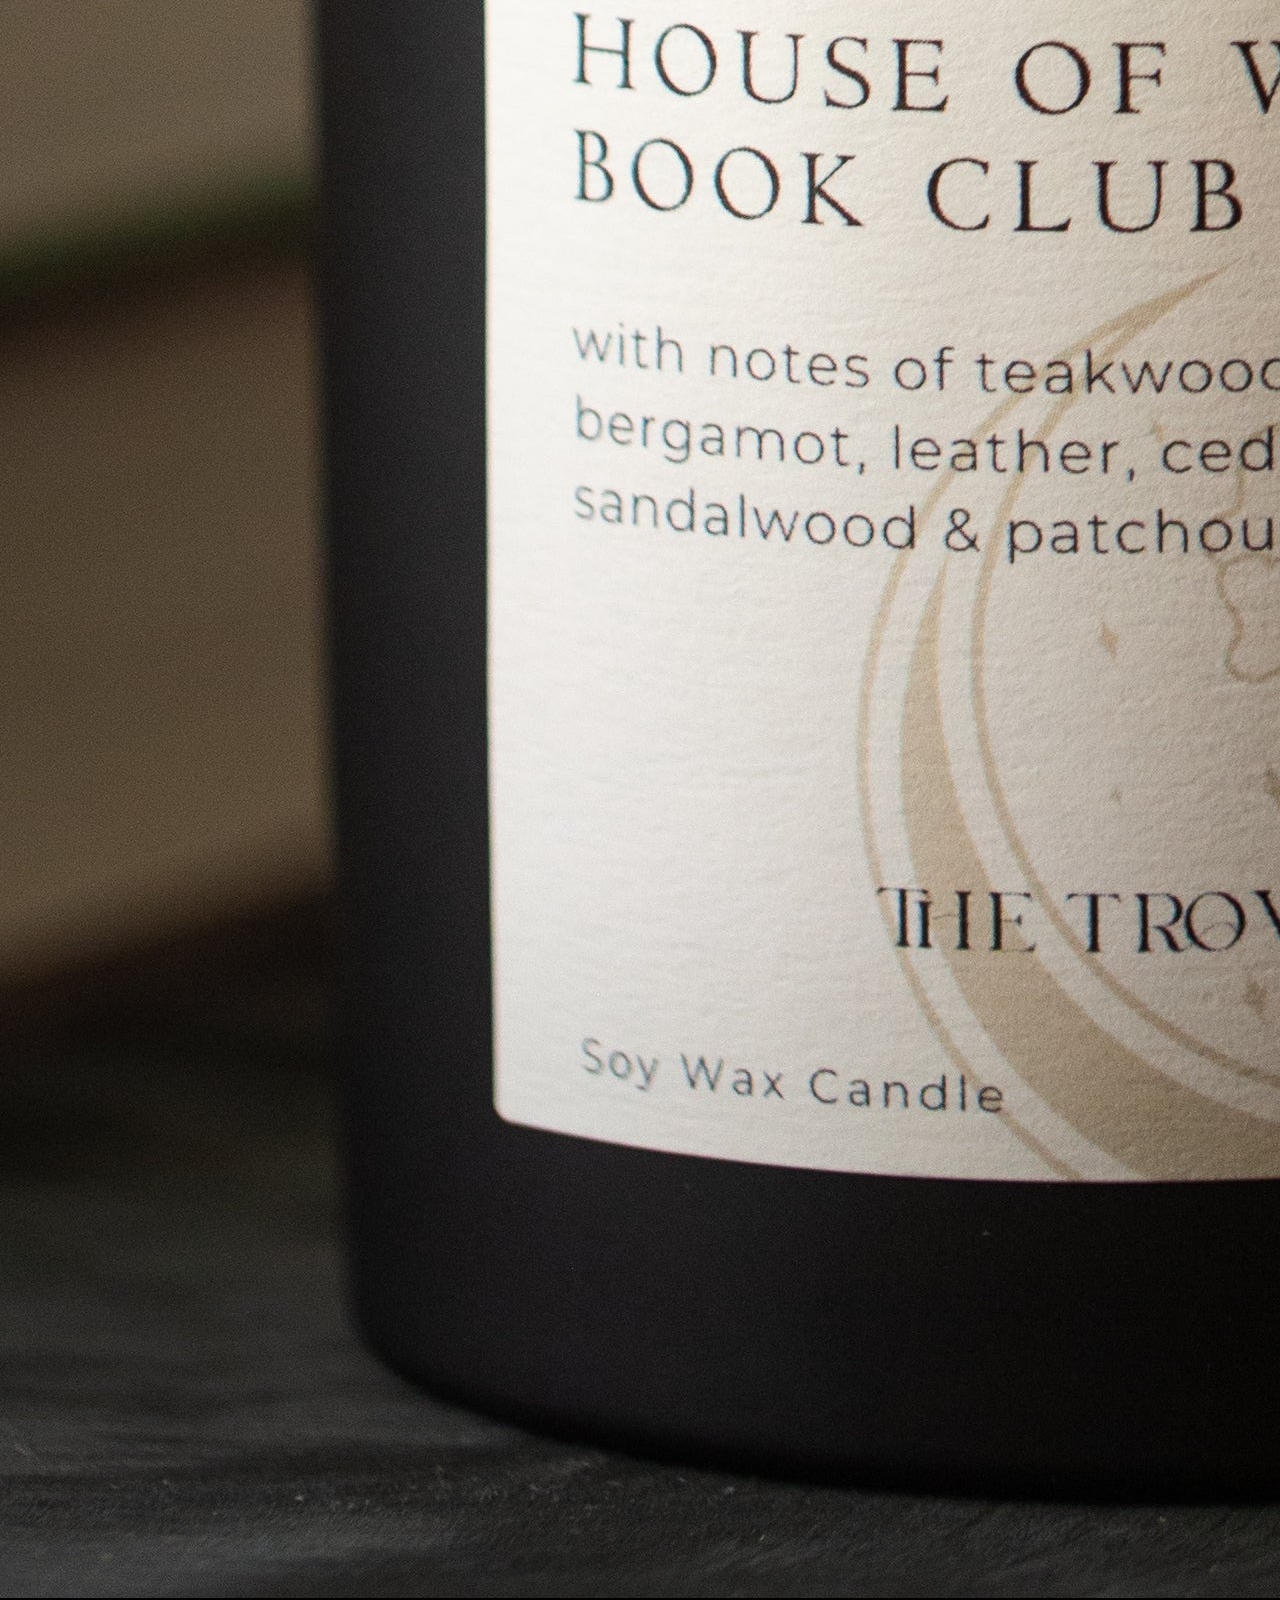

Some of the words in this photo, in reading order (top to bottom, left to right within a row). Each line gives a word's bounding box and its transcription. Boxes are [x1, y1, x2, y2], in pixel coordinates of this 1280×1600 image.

[572, 12, 950, 115] HOUSE
[1015, 41, 1167, 116] OF
[572, 129, 863, 228] BOOK
[926, 156, 1245, 235] CLUB
[572, 322, 684, 376] with
[710, 341, 870, 389] notes
[895, 345, 955, 393] of
[574, 396, 867, 476] bergamot,
[894, 425, 1136, 482] leather,
[574, 481, 916, 550] sandalwood
[945, 509, 981, 555] &
[877, 885, 1037, 952] THE
[581, 1037, 659, 1093] Soy
[681, 1054, 784, 1102] Wax
[810, 1068, 1004, 1115] Candle
